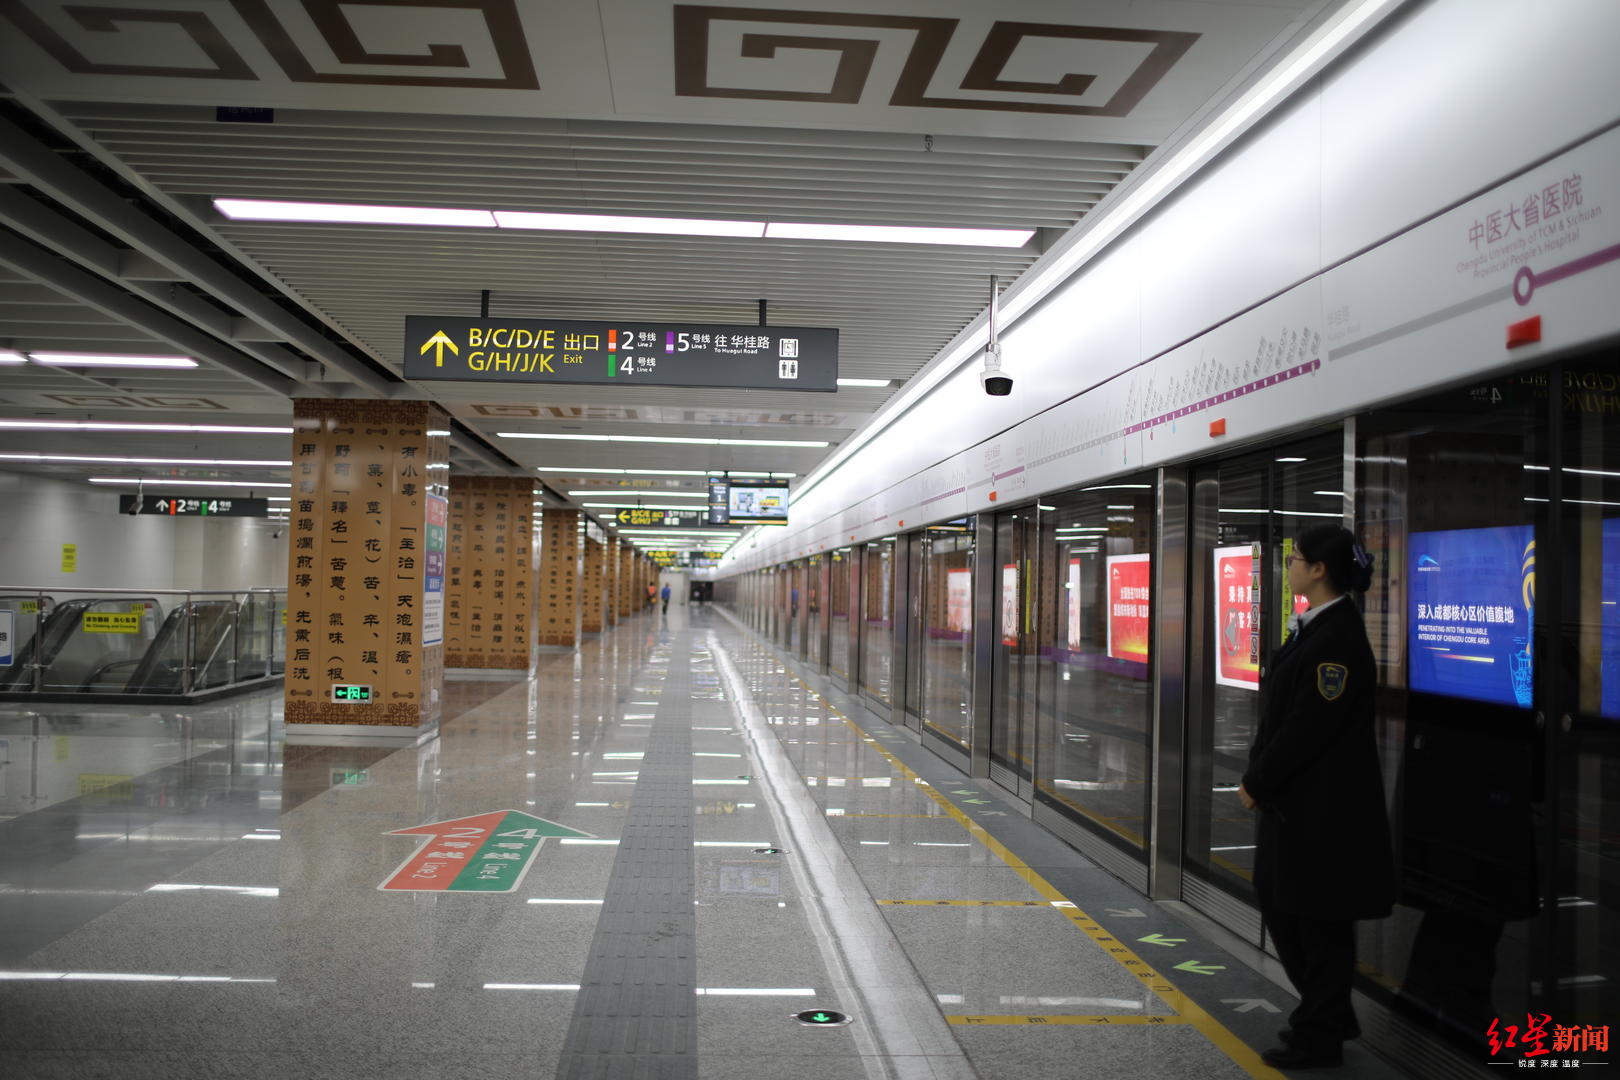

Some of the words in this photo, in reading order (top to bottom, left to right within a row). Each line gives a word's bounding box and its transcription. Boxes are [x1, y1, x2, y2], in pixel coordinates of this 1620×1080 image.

[1468, 173, 1583, 250] 中医大省医院
[468, 328, 555, 349] B/C/D/E
[564, 333, 599, 351] 出口
[621, 331, 635, 350] 2
[637, 332, 656, 342] 号线
[677, 333, 690, 351] 5
[691, 334, 711, 343] 号线
[730, 336, 770, 349] 华桂路
[468, 352, 555, 373] G/H/J/K
[563, 354, 583, 364] Exit
[620, 356, 634, 375] 4
[637, 357, 656, 367] 号线
[177, 500, 187, 512] 2
[208, 500, 218, 513] 4
[1417, 603, 1515, 624] 深入成都核心区价值腹地
[1418, 625, 1445, 633] PENETRATING
[1465, 627, 1488, 635] VALUABLE
[1418, 633, 1437, 641] INTERIOR
[1443, 635, 1464, 643] CHENGDU
[1477, 636, 1490, 645] AREA
